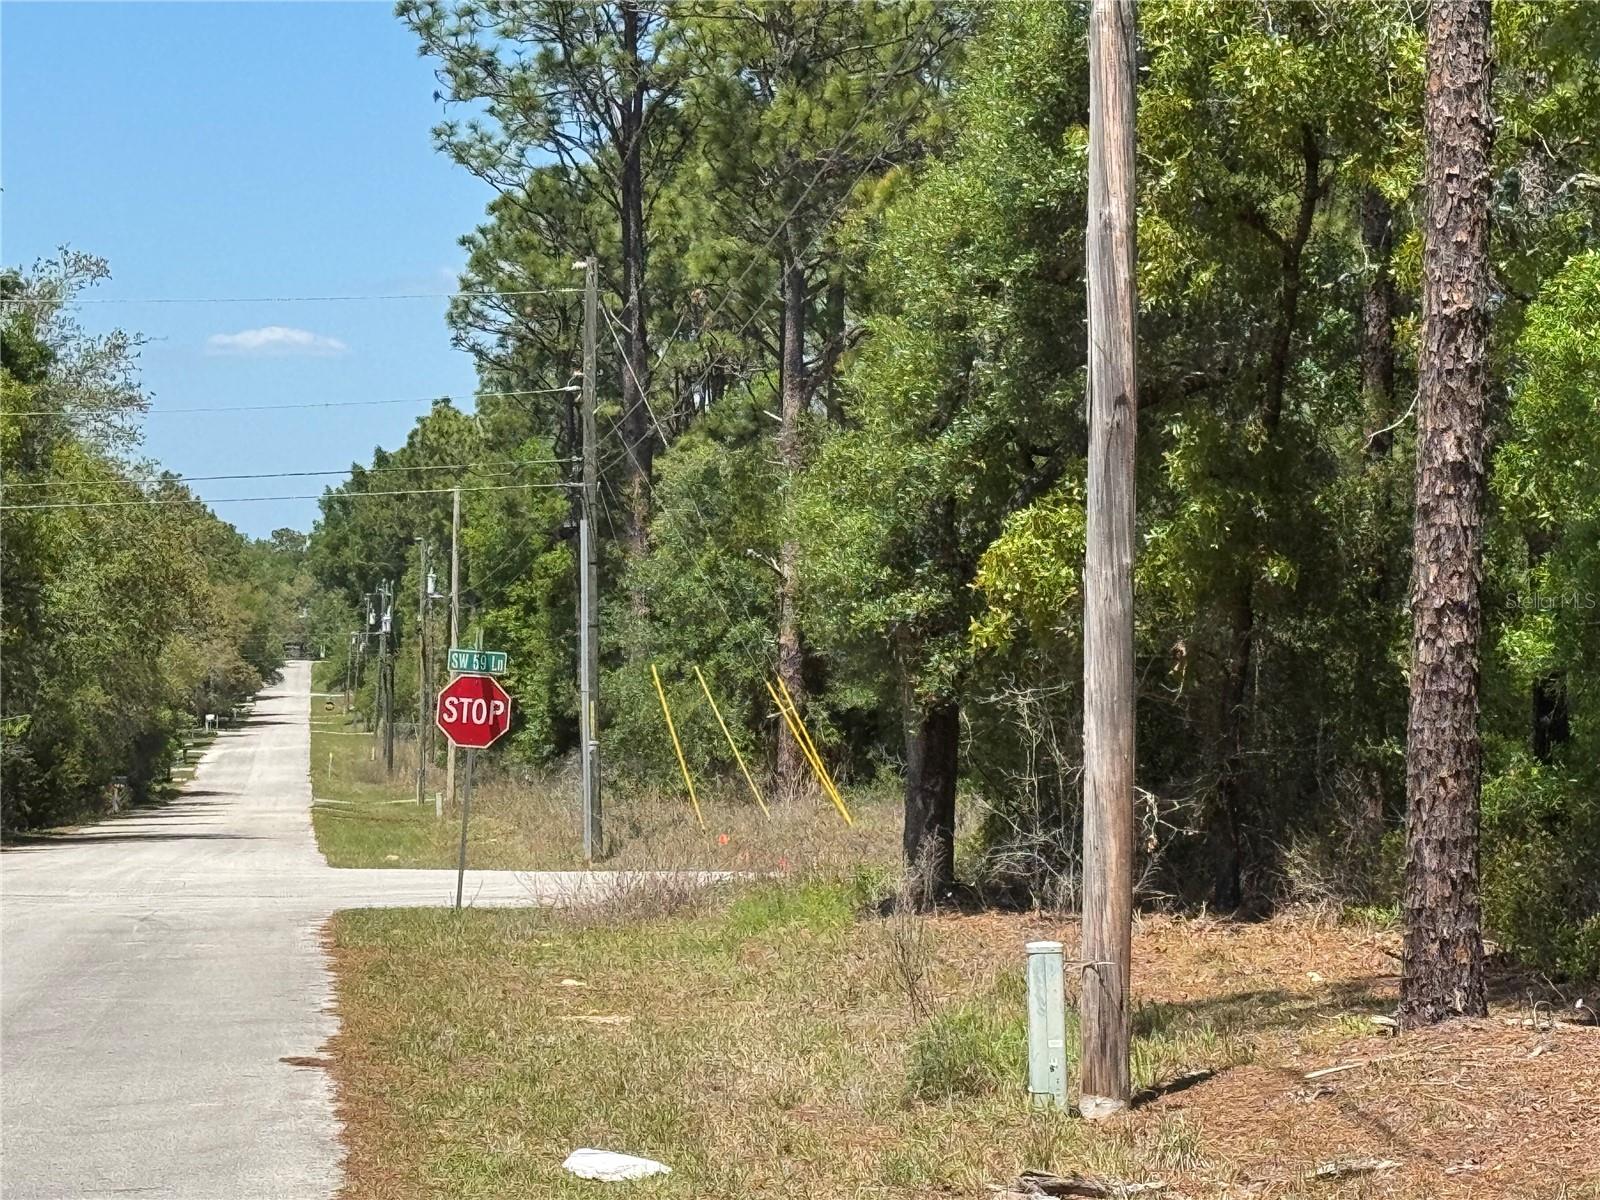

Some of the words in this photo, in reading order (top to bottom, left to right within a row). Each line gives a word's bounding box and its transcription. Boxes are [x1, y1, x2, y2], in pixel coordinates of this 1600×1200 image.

[451, 652, 469, 669] SW
[473, 653, 487, 671] 59
[491, 655, 504, 671] Ln
[442, 696, 505, 725] STOP
